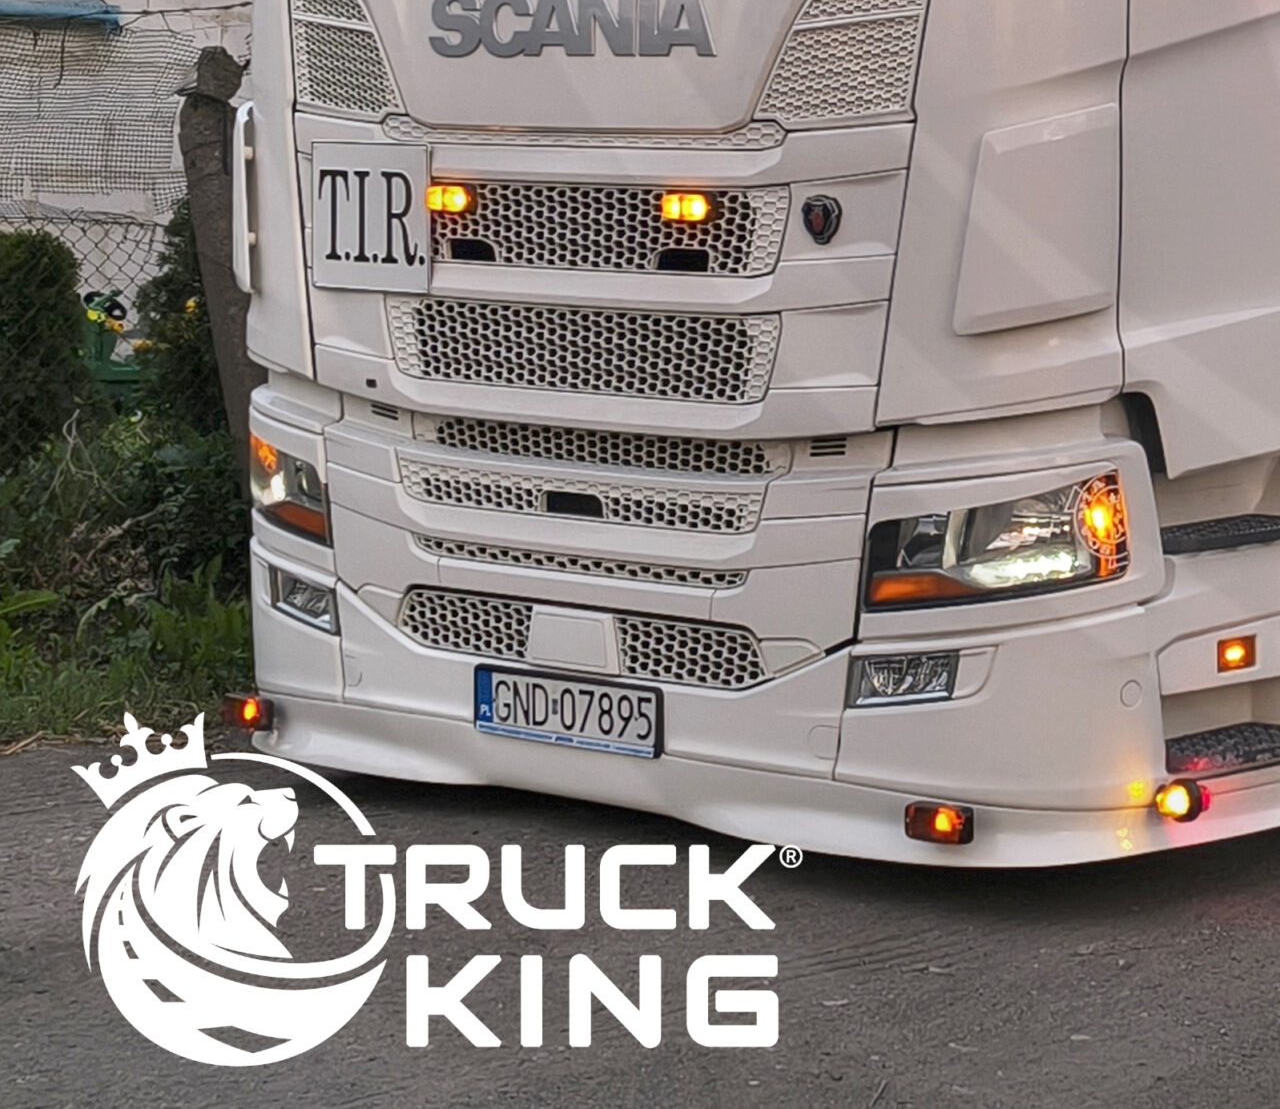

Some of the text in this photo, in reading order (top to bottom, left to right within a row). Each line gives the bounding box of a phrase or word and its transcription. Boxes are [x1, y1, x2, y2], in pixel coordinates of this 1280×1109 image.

[318, 169, 425, 267] T.I.R.
[495, 680, 549, 727] GND
[560, 688, 653, 740] 07895
